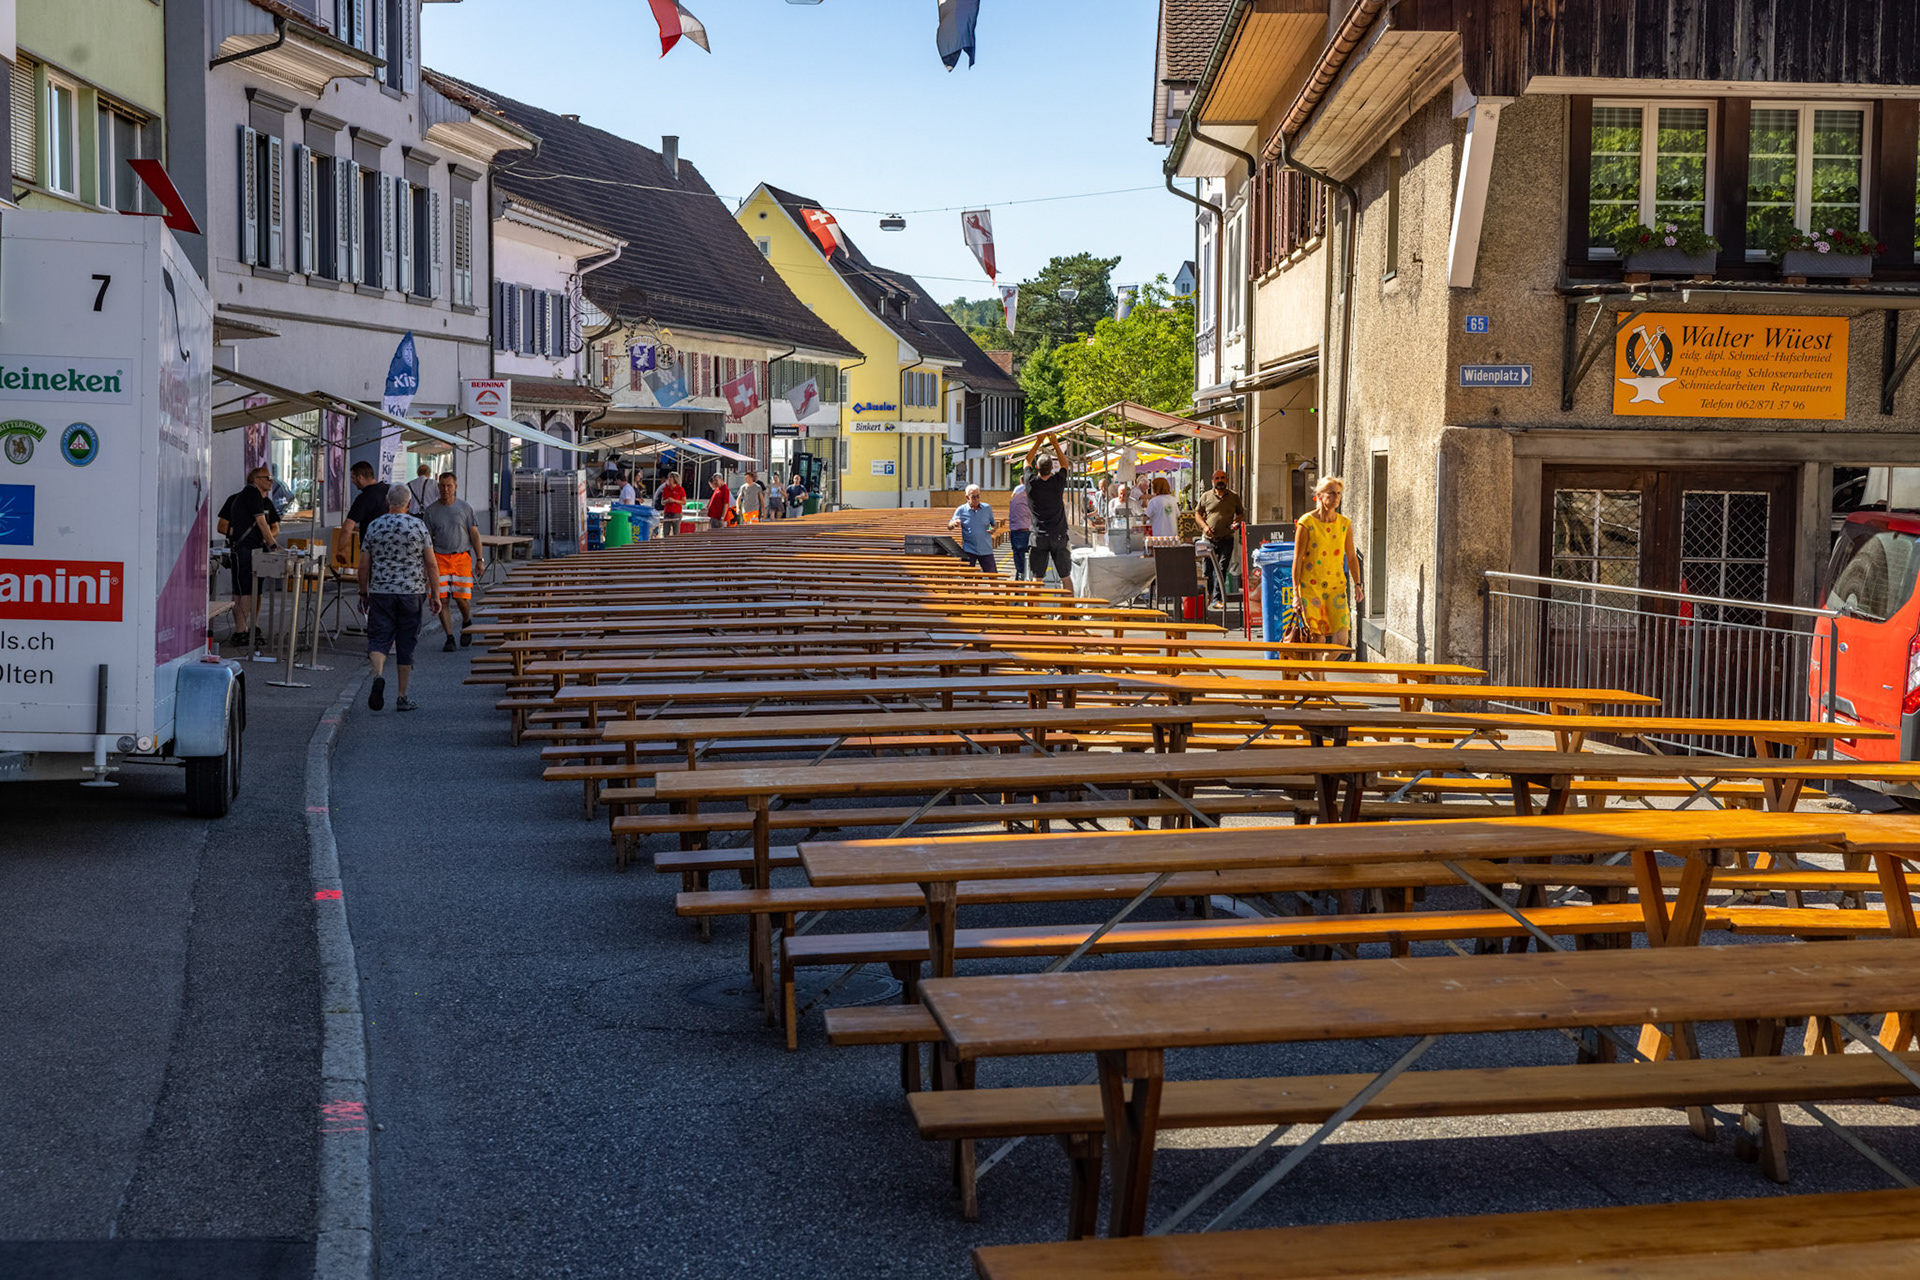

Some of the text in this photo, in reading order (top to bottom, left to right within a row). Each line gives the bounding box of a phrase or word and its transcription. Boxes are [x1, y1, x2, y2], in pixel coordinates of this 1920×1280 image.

[91, 274, 111, 311] 7
[1470, 317, 1484, 331] 65
[1682, 325, 1834, 350] Walter Wüest
[1680, 349, 1702, 362] eidg.
[1705, 350, 1725, 363] dipl.
[1464, 369, 1519, 384] Widenplatz
[1680, 366, 1833, 380] Hufbeschlag Schlosserarbeiten
[1678, 379, 1832, 394] Schmiedearbeiten Reparaturen
[865, 401, 897, 411] Basler
[1700, 399, 1805, 411] Telefon 062/871 37 96
[855, 422, 882, 432] Binkert
[886, 465, 893, 473] P
[1270, 531, 1284, 540] NEW
